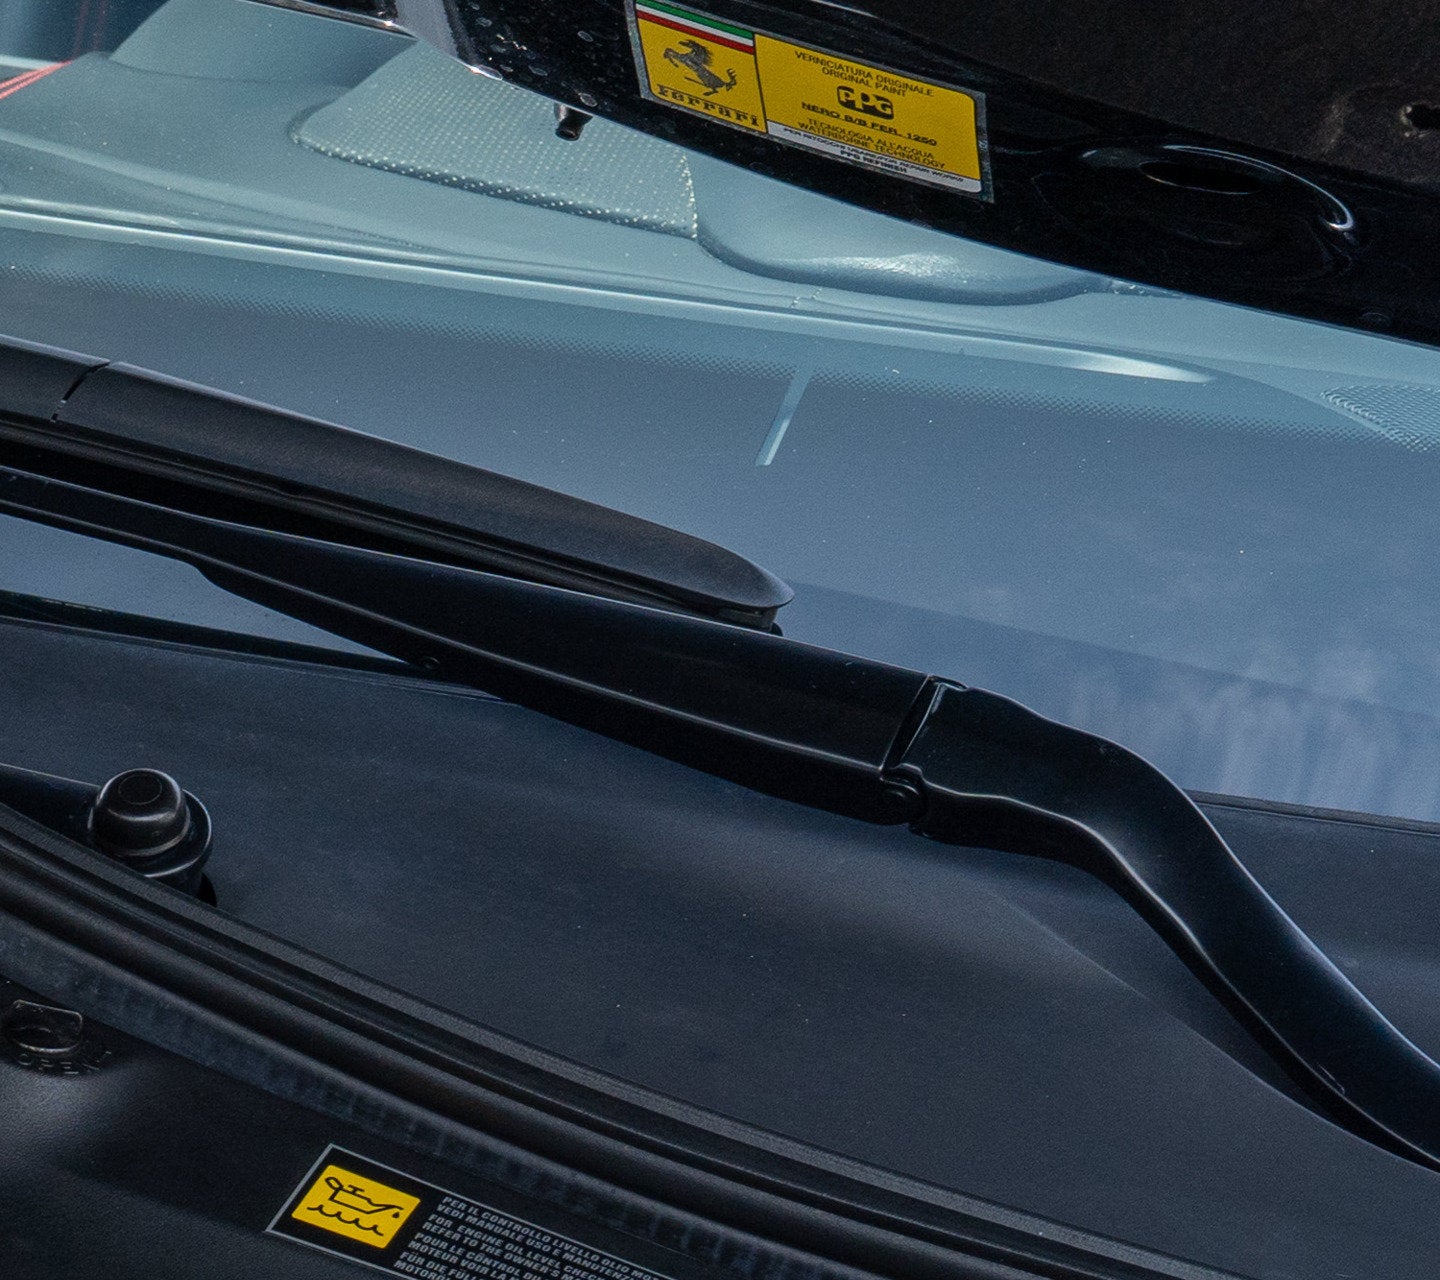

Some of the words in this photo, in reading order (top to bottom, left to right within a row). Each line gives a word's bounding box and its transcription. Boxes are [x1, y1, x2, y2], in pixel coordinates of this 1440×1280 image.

[794, 50, 873, 80] VERNICIATURA
[875, 74, 933, 97] ORIGINALE
[821, 66, 871, 87] ORIGINAL
[874, 81, 906, 97] PAINT
[656, 82, 759, 127] Ferrari
[836, 84, 894, 121] PPG
[413, 1232, 449, 1249] POUR
[448, 1244, 465, 1255] LE
[421, 1221, 462, 1241] REFER
[461, 1236, 479, 1247] TO
[479, 1243, 504, 1256] THE
[427, 1213, 454, 1228] FOR
[456, 1224, 504, 1247] ENGINE
[504, 1242, 526, 1255] OIL
[525, 1250, 563, 1269] LEVEL
[435, 1203, 464, 1219] VEDI
[464, 1215, 525, 1242] MANUALE
[524, 1238, 552, 1252] USO
[551, 1248, 561, 1256] E
[441, 1196, 467, 1210] PER
[466, 1206, 481, 1215] IL
[480, 1211, 552, 1243] CONTROLLO
[552, 1239, 600, 1261] LIVELLO
[600, 1257, 630, 1273] OLIO
[407, 1240, 459, 1263] MOTEUR
[458, 1259, 490, 1274] VOIR
[489, 1270, 507, 1280] LA
[425, 1260, 448, 1273] DIE
